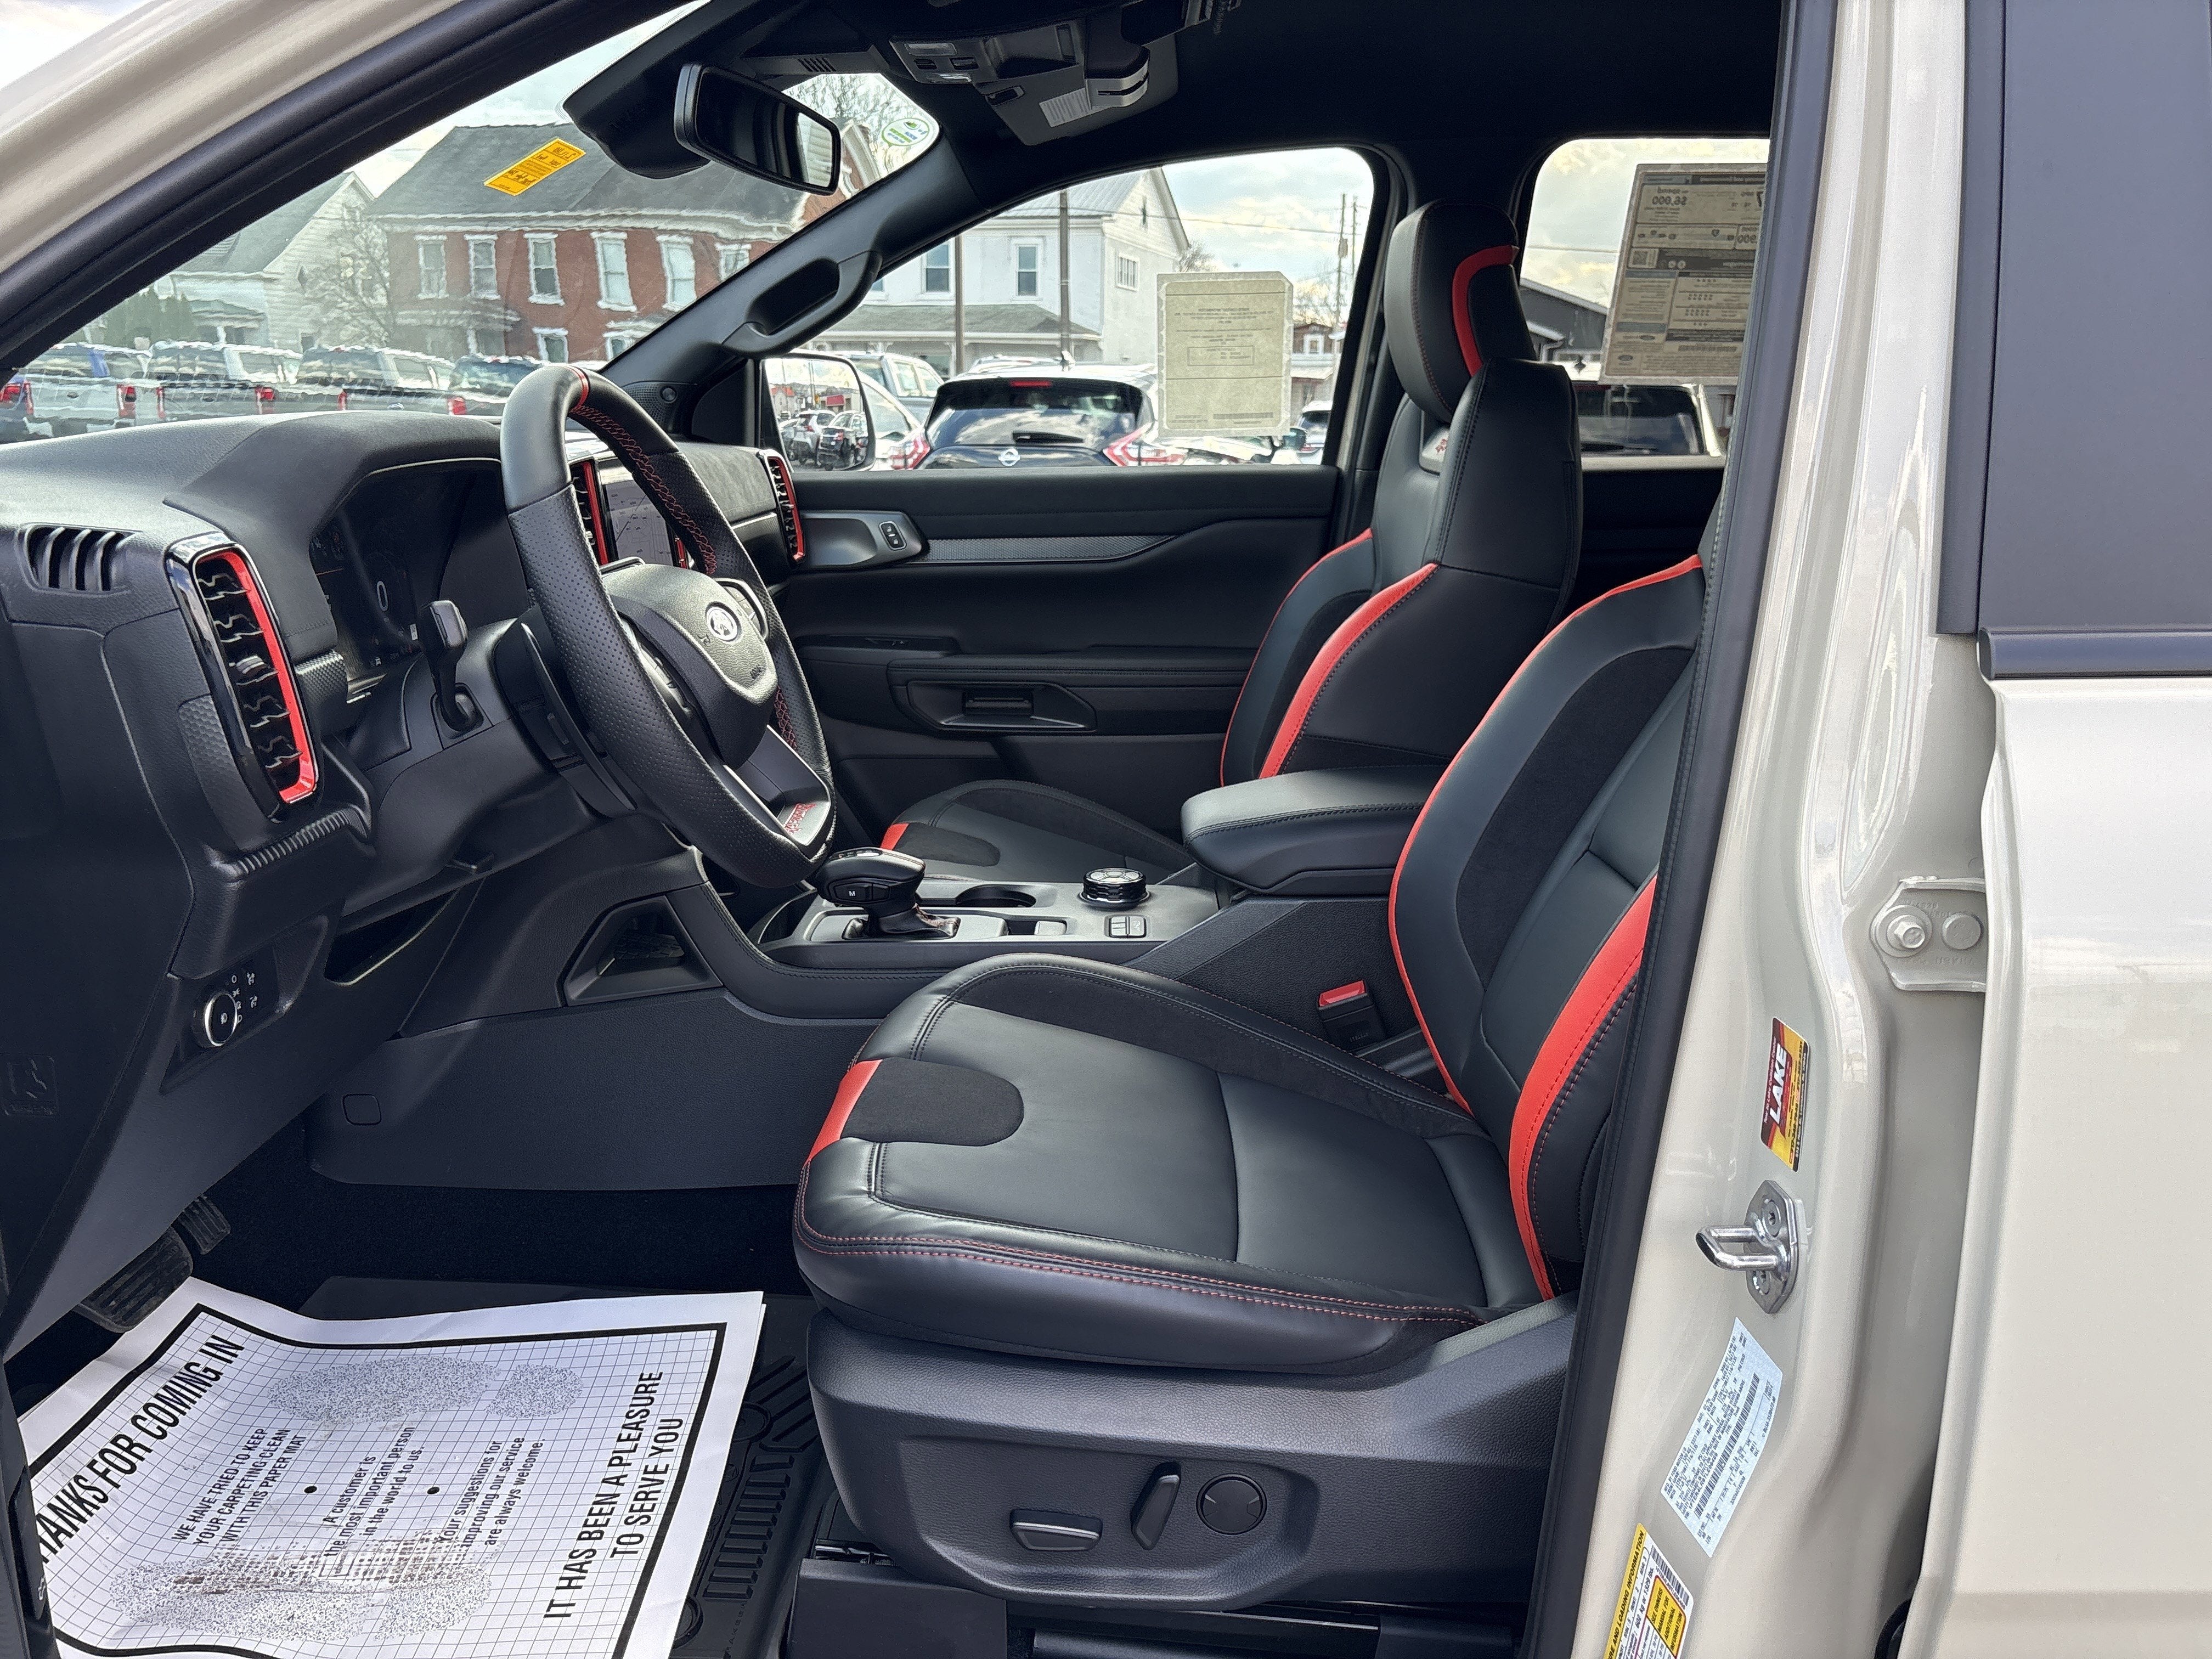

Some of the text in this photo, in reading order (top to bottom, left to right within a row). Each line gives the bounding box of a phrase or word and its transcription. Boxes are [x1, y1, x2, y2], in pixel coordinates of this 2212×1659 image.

[1770, 1043, 1787, 1125] LAKE
[35, 1334, 245, 1564] ANKS FOR COMING IN
[171, 1429, 268, 1540] WE HAVE TRIED TO KEEP
[192, 1429, 291, 1544] YOUR CARPETING CLEAN
[219, 1435, 307, 1542] WITH THIS PAPER MAT
[324, 1427, 415, 1556] the most important person
[332, 1468, 369, 1514] customer
[359, 1447, 425, 1536] in the world to us.
[437, 1441, 502, 1542] Your suggestions for
[460, 1437, 524, 1548] improving our service
[484, 1438, 545, 1545] are always welcome.
[544, 1371, 663, 1618] IT HAS BEEN A PLEASURE
[610, 1418, 684, 1559] TO SERVE YOU
[1611, 1626, 1620, 1647] AND
[1616, 1587, 1629, 1628] LOADING
[1626, 1528, 1644, 1590] INFORMATION
[1638, 1601, 1645, 1615] kg
[1654, 1586, 1663, 1613] OWNERS
[1657, 1606, 1666, 1633] MANUAL
[1664, 1605, 1675, 1640] ADDITIONAL
[1669, 1611, 1682, 1651] INFORMATION
